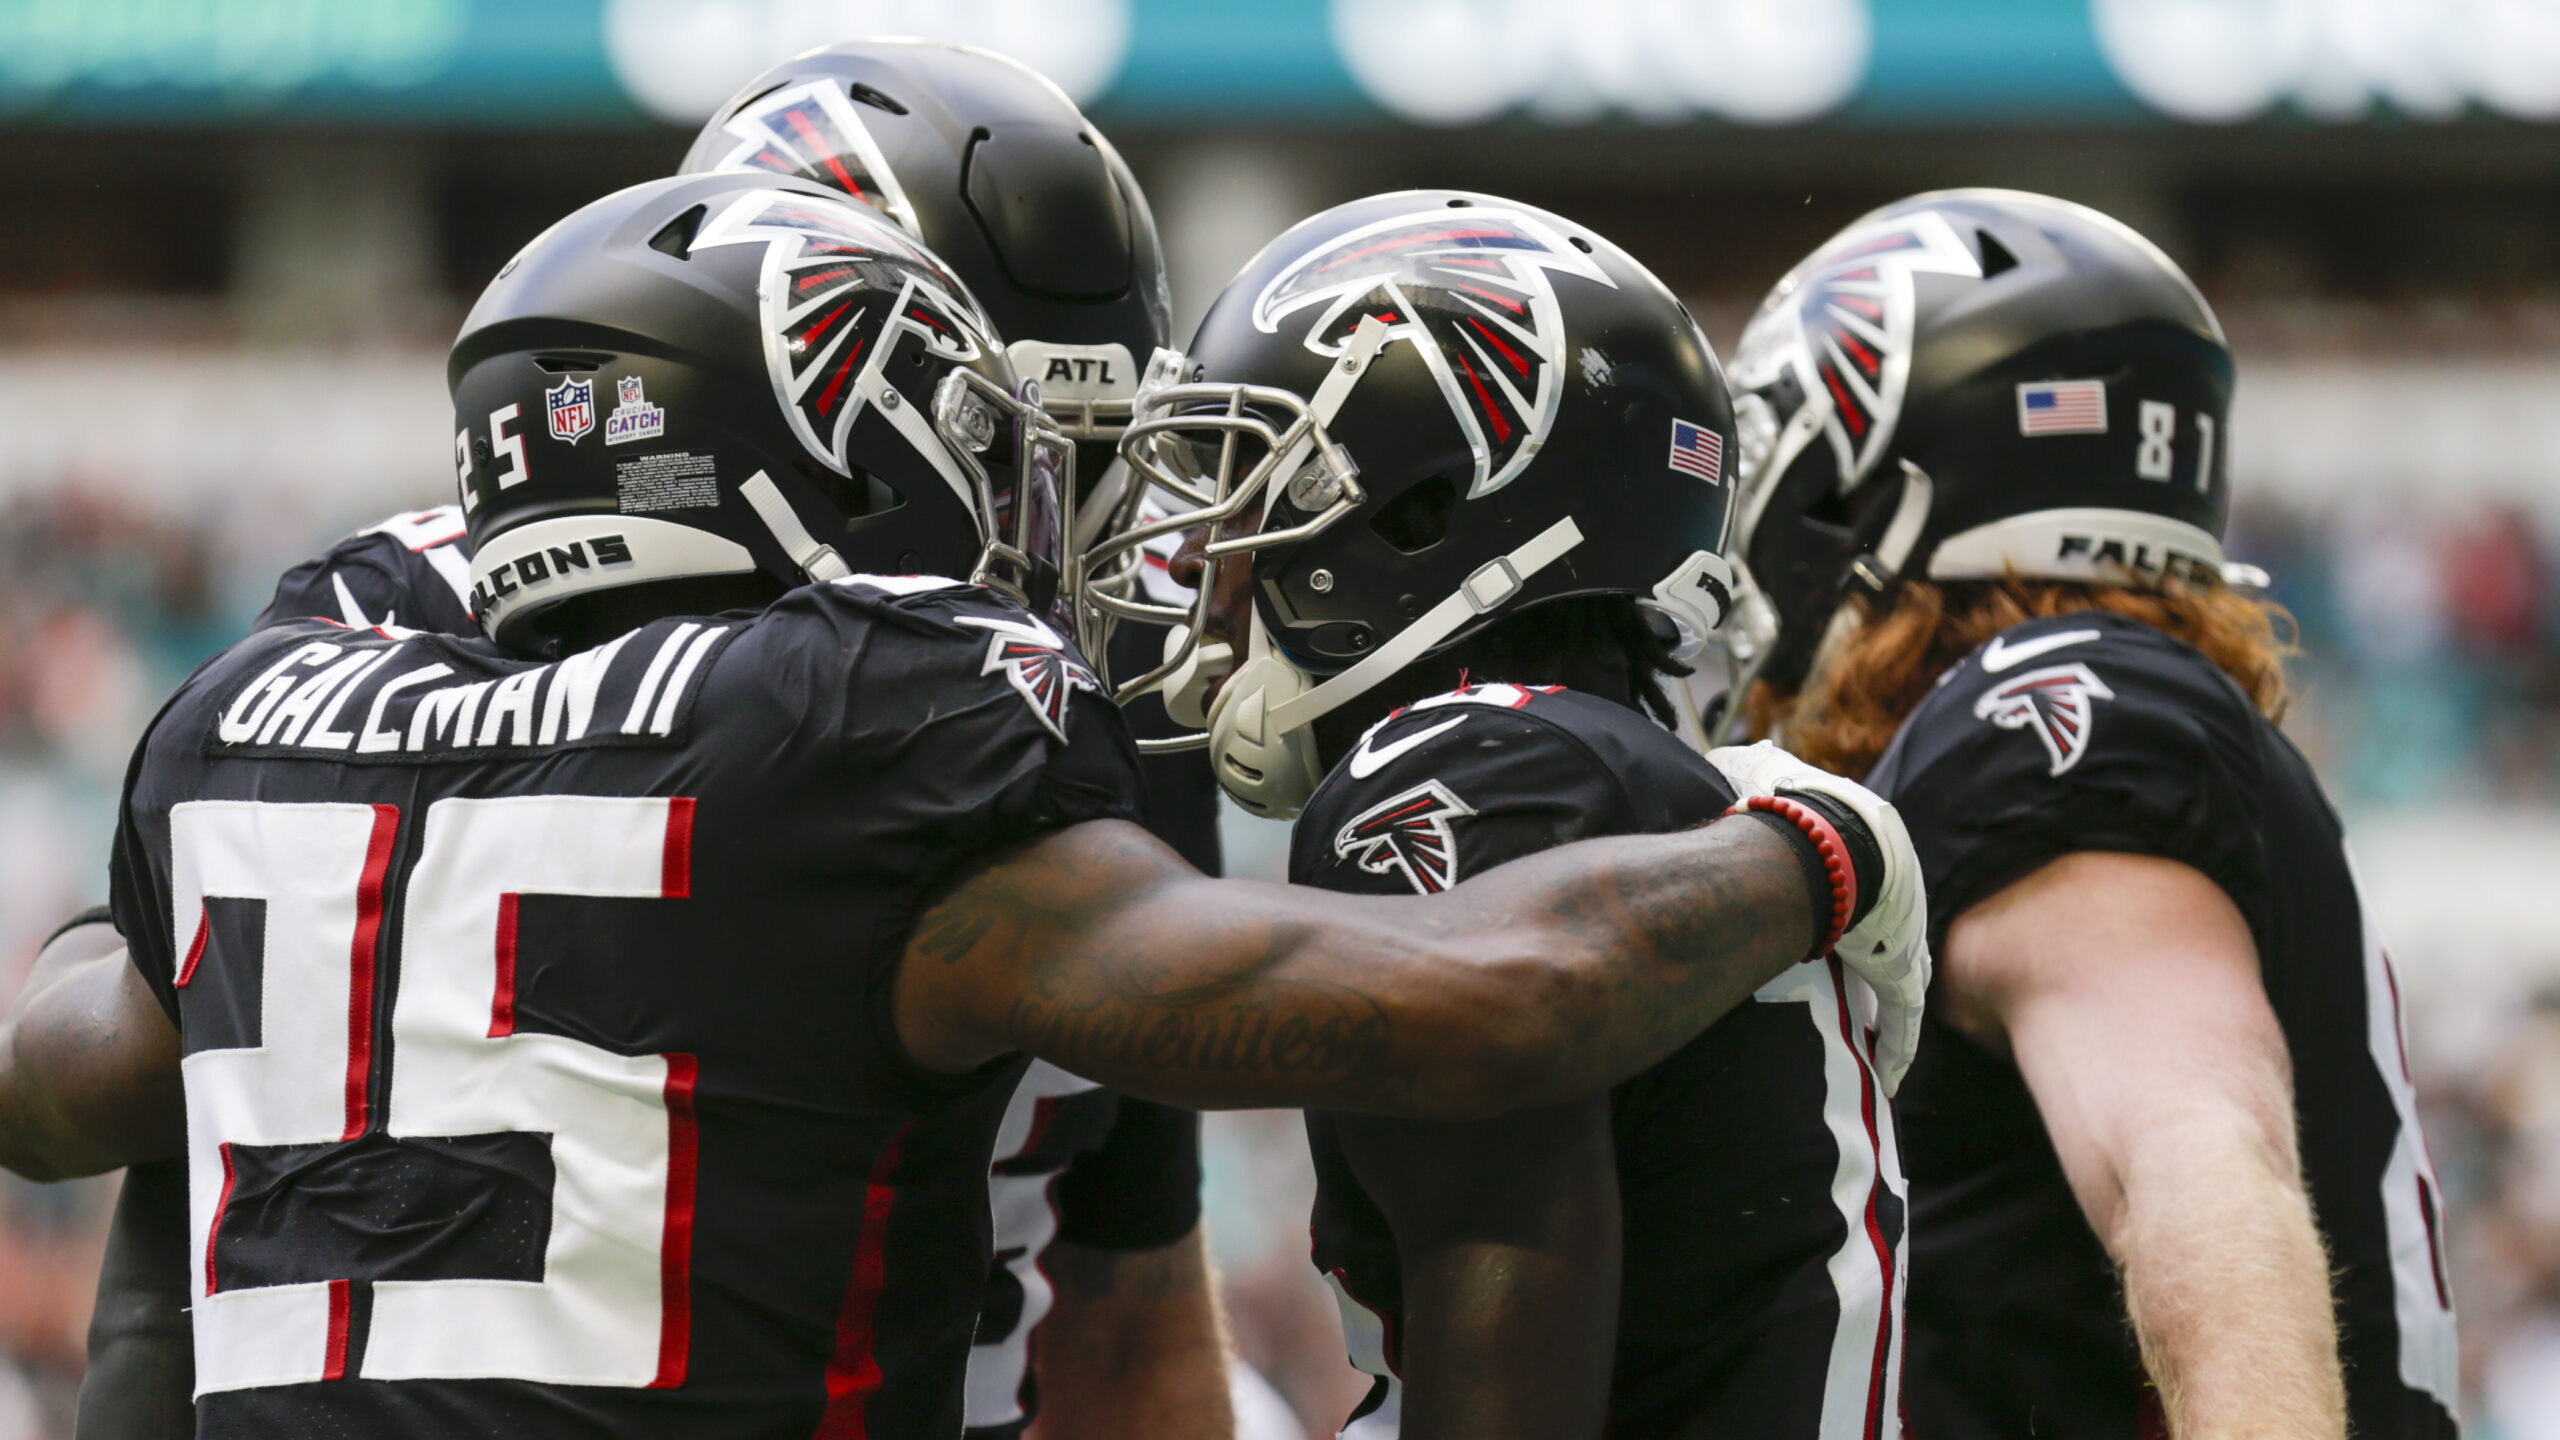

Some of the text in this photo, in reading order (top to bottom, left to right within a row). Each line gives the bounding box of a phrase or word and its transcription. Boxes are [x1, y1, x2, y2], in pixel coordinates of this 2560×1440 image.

[1045, 357, 1115, 385] ATL
[623, 388, 640, 401] NFL
[554, 405, 590, 434] NFL
[608, 410, 661, 435] CATCH
[614, 404, 653, 417] CRUCIAL
[456, 402, 530, 514] 25
[639, 452, 690, 462] WARNING
[2136, 399, 2214, 493] 81
[221, 624, 729, 753] GALLMAN II
[170, 795, 698, 1402] 25
